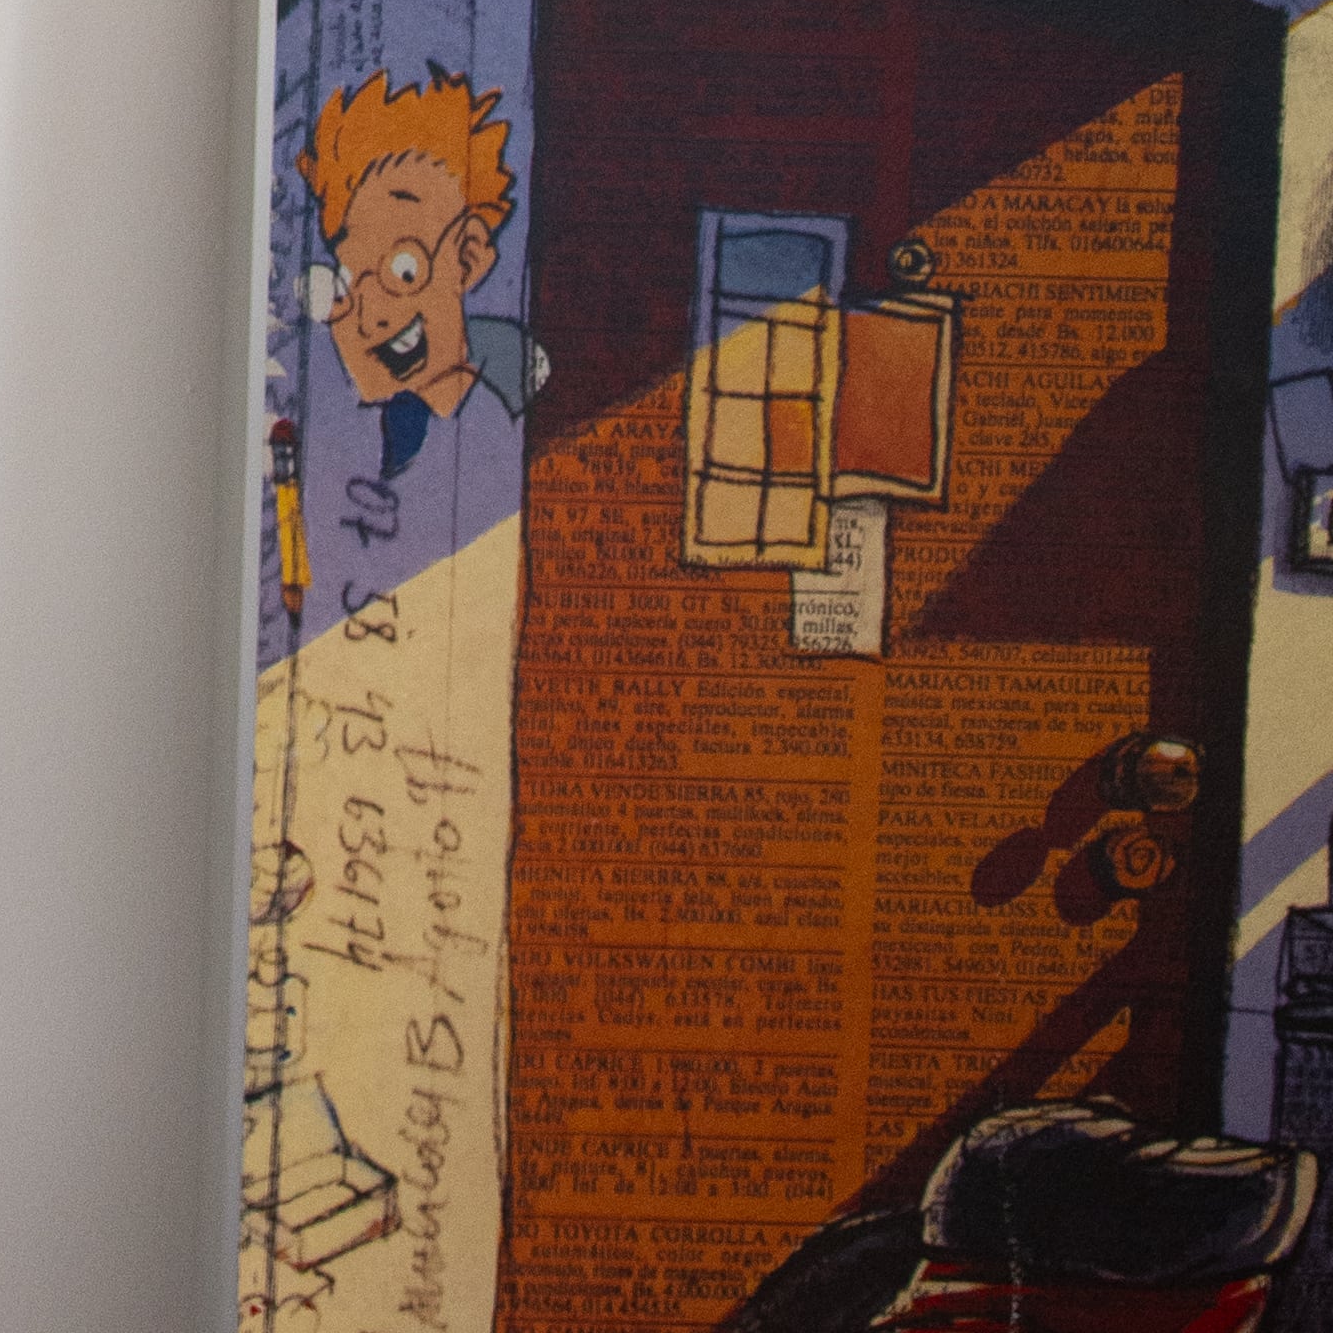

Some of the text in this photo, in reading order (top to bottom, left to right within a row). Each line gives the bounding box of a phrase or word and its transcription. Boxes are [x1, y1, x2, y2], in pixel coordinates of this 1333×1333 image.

[1003, 196, 1110, 213] MARACAY
[803, 619, 859, 637] millas,
[885, 674, 990, 692] MARIACHI
[877, 810, 933, 827] PARA
